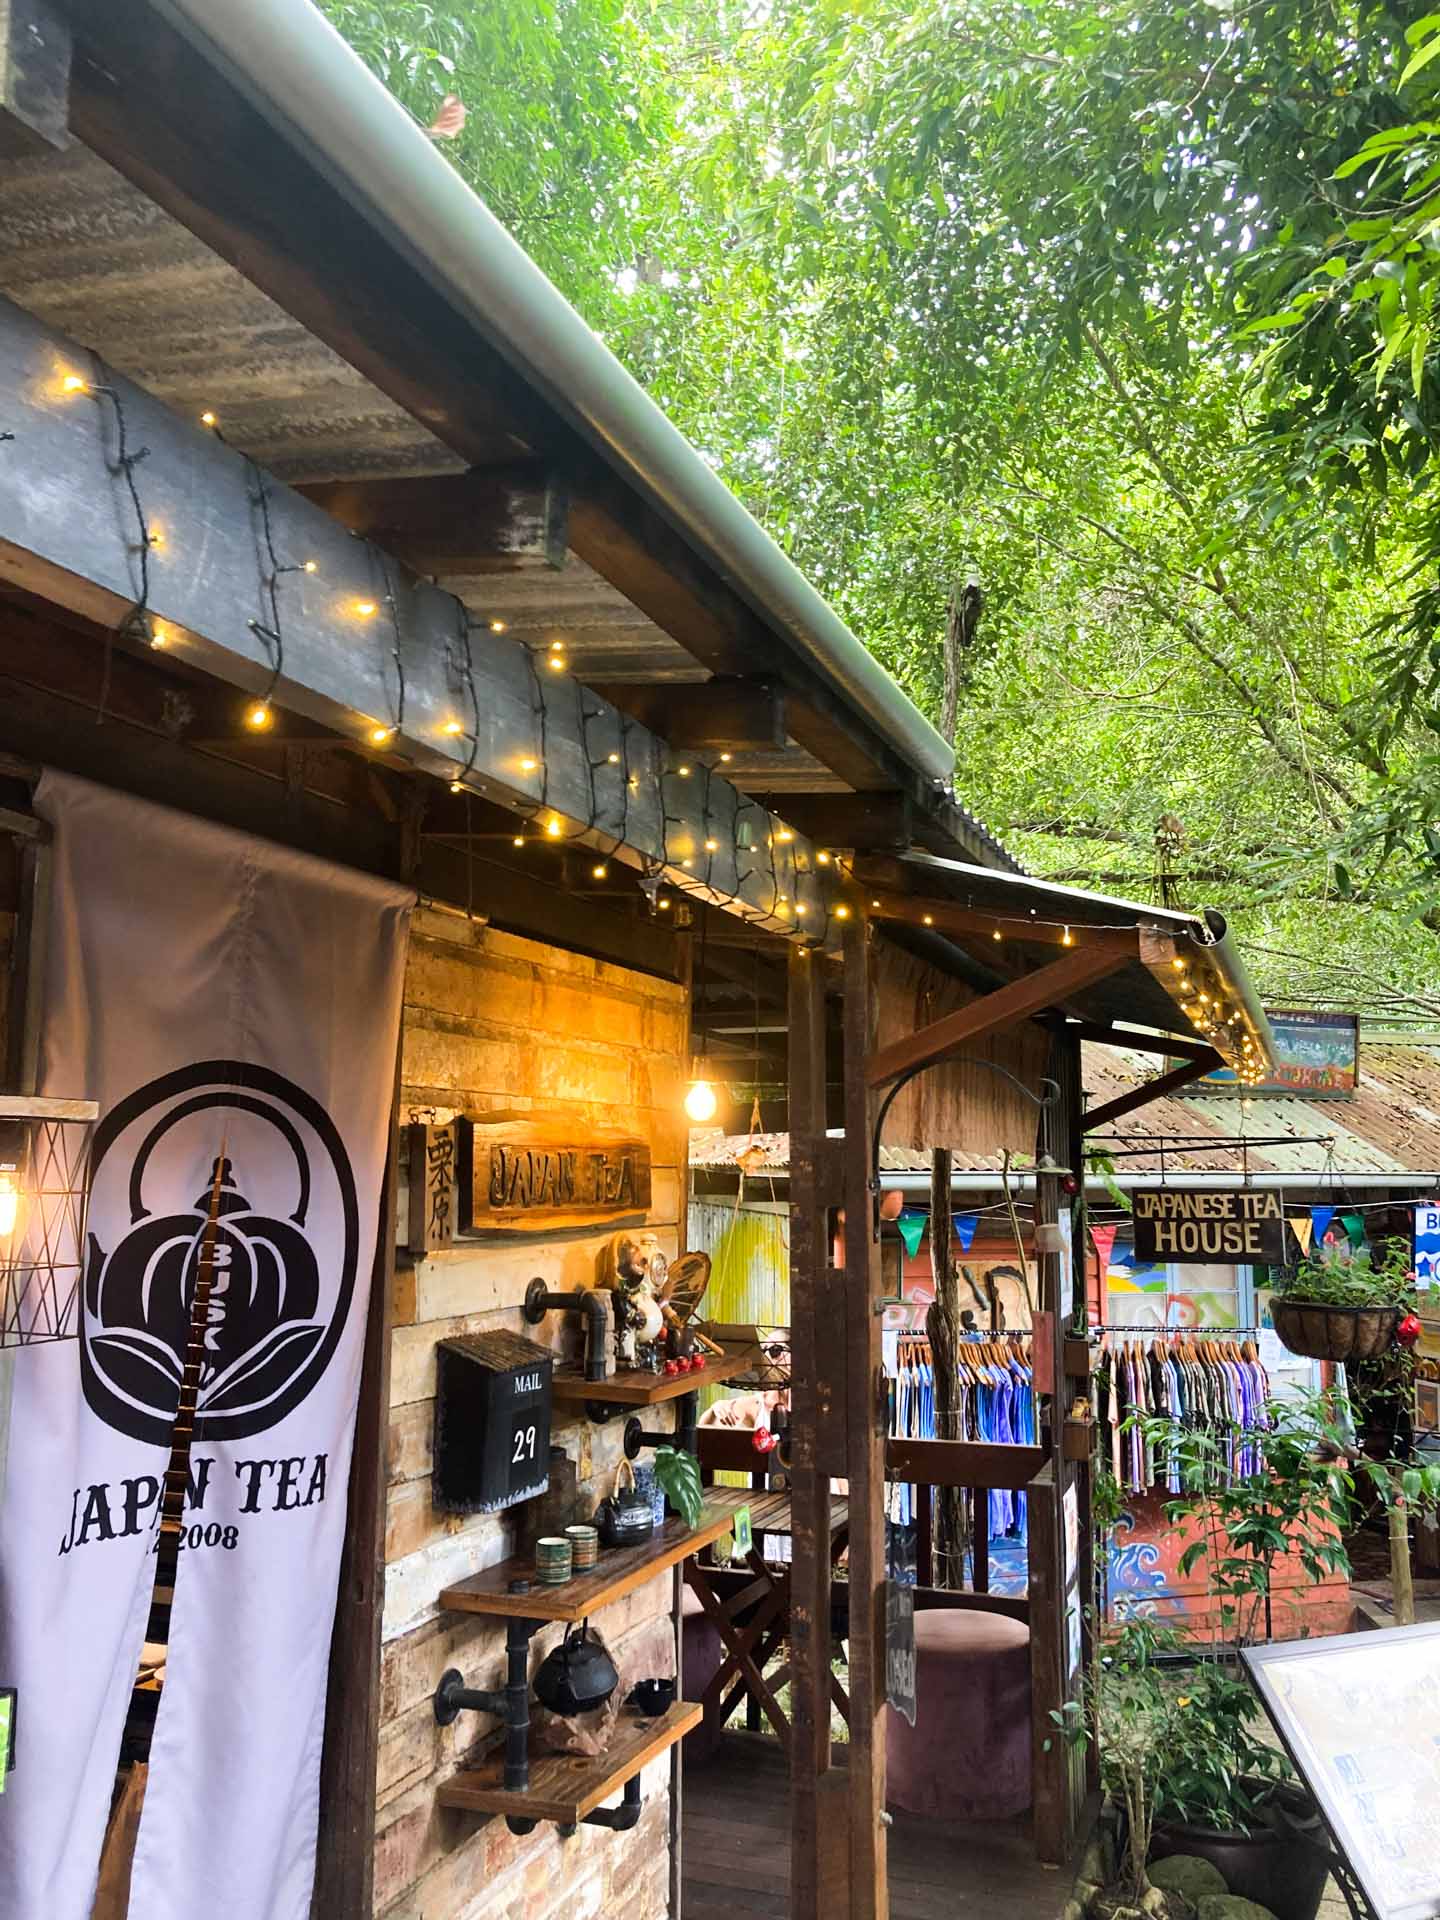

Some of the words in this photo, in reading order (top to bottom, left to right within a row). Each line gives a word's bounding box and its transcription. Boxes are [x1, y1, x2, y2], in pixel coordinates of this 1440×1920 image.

[489, 1149, 576, 1207] JAPAN
[1136, 1193, 1236, 1219] JAPANESE
[1238, 1193, 1281, 1219] TEA
[1154, 1220, 1262, 1254] HOUSE
[514, 1373, 543, 1394] MAIL
[511, 1425, 536, 1464] 29
[234, 1453, 329, 1514] TEA
